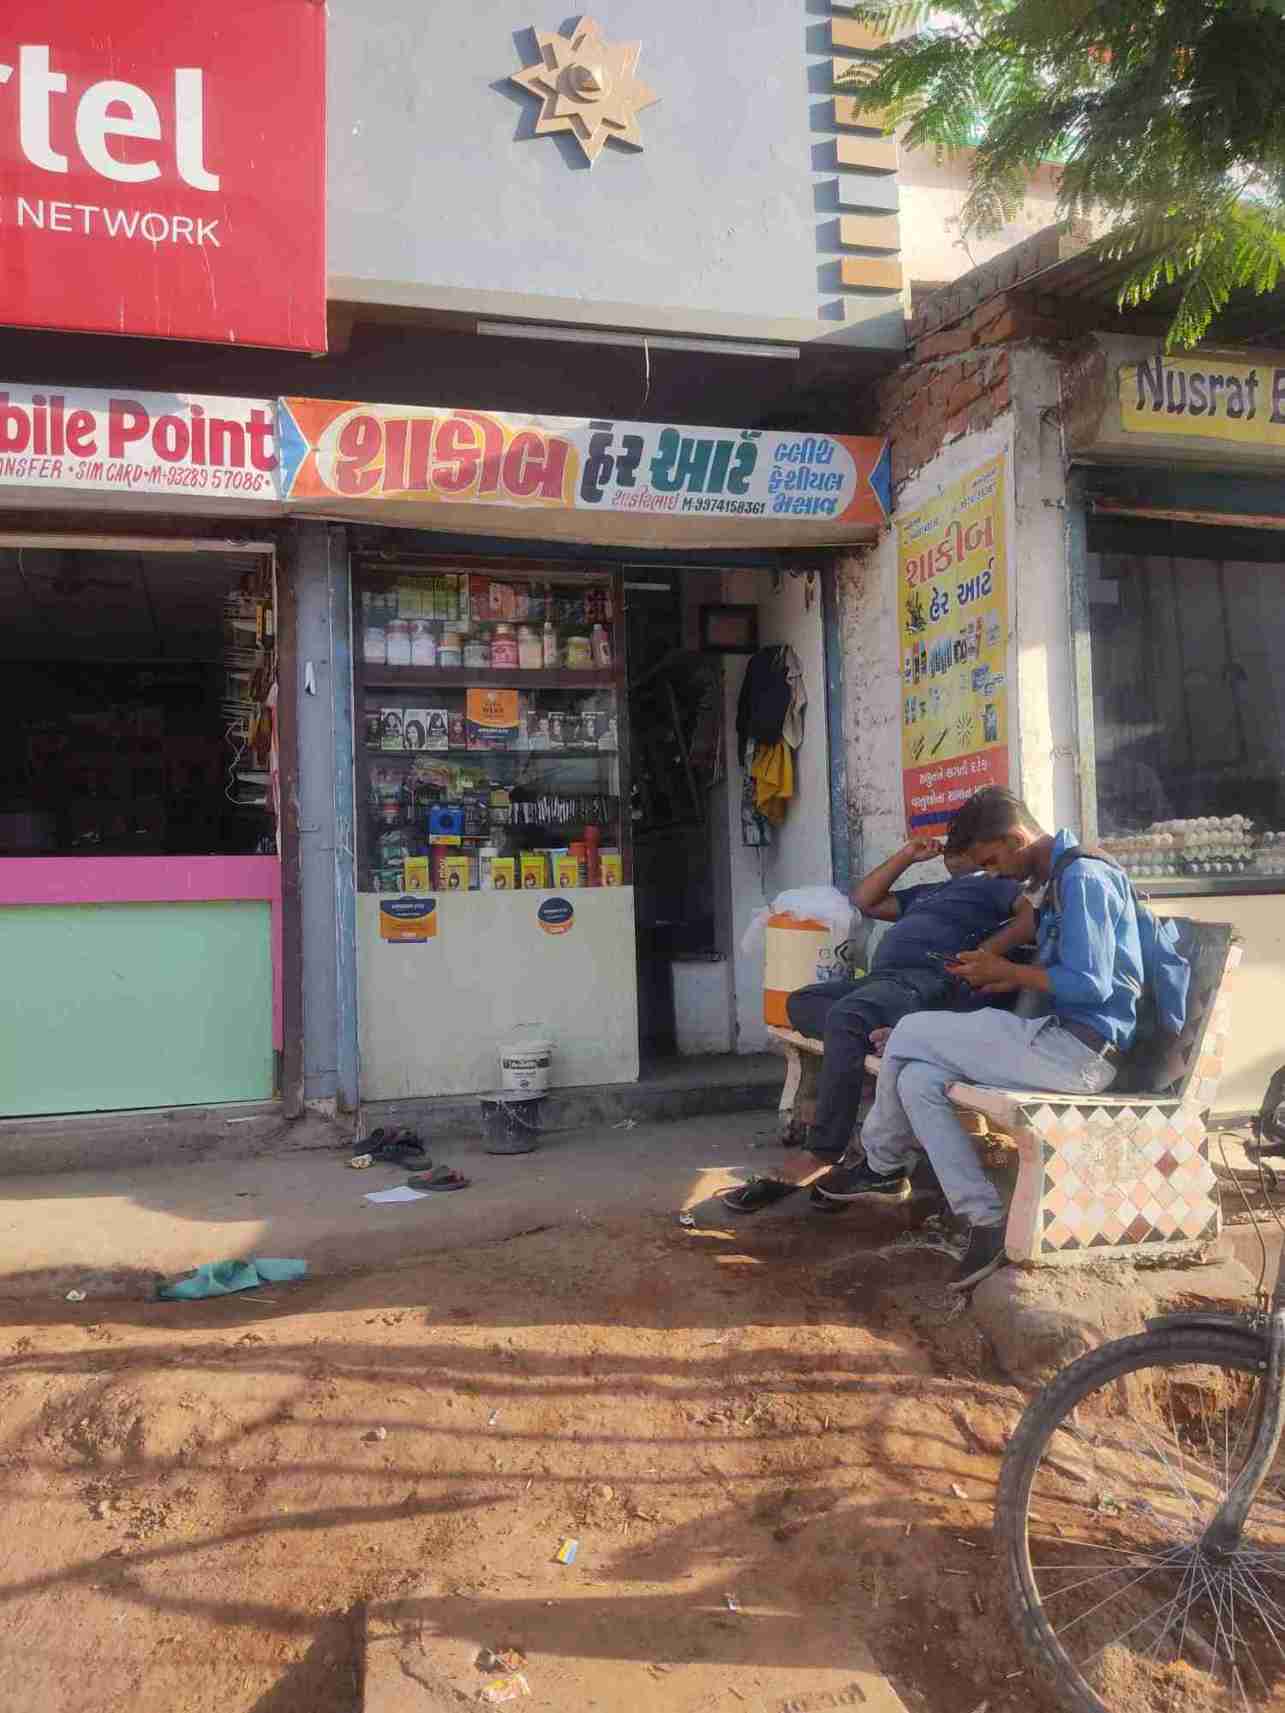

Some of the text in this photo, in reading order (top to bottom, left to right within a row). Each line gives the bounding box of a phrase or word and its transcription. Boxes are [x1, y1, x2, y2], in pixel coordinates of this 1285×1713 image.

[0, 45, 220, 191] tel
[16, 197, 220, 248] NETWORK
[1136, 356, 1258, 420] Nusrat
[109, 399, 279, 472] Point
[75, 461, 102, 481] SIM
